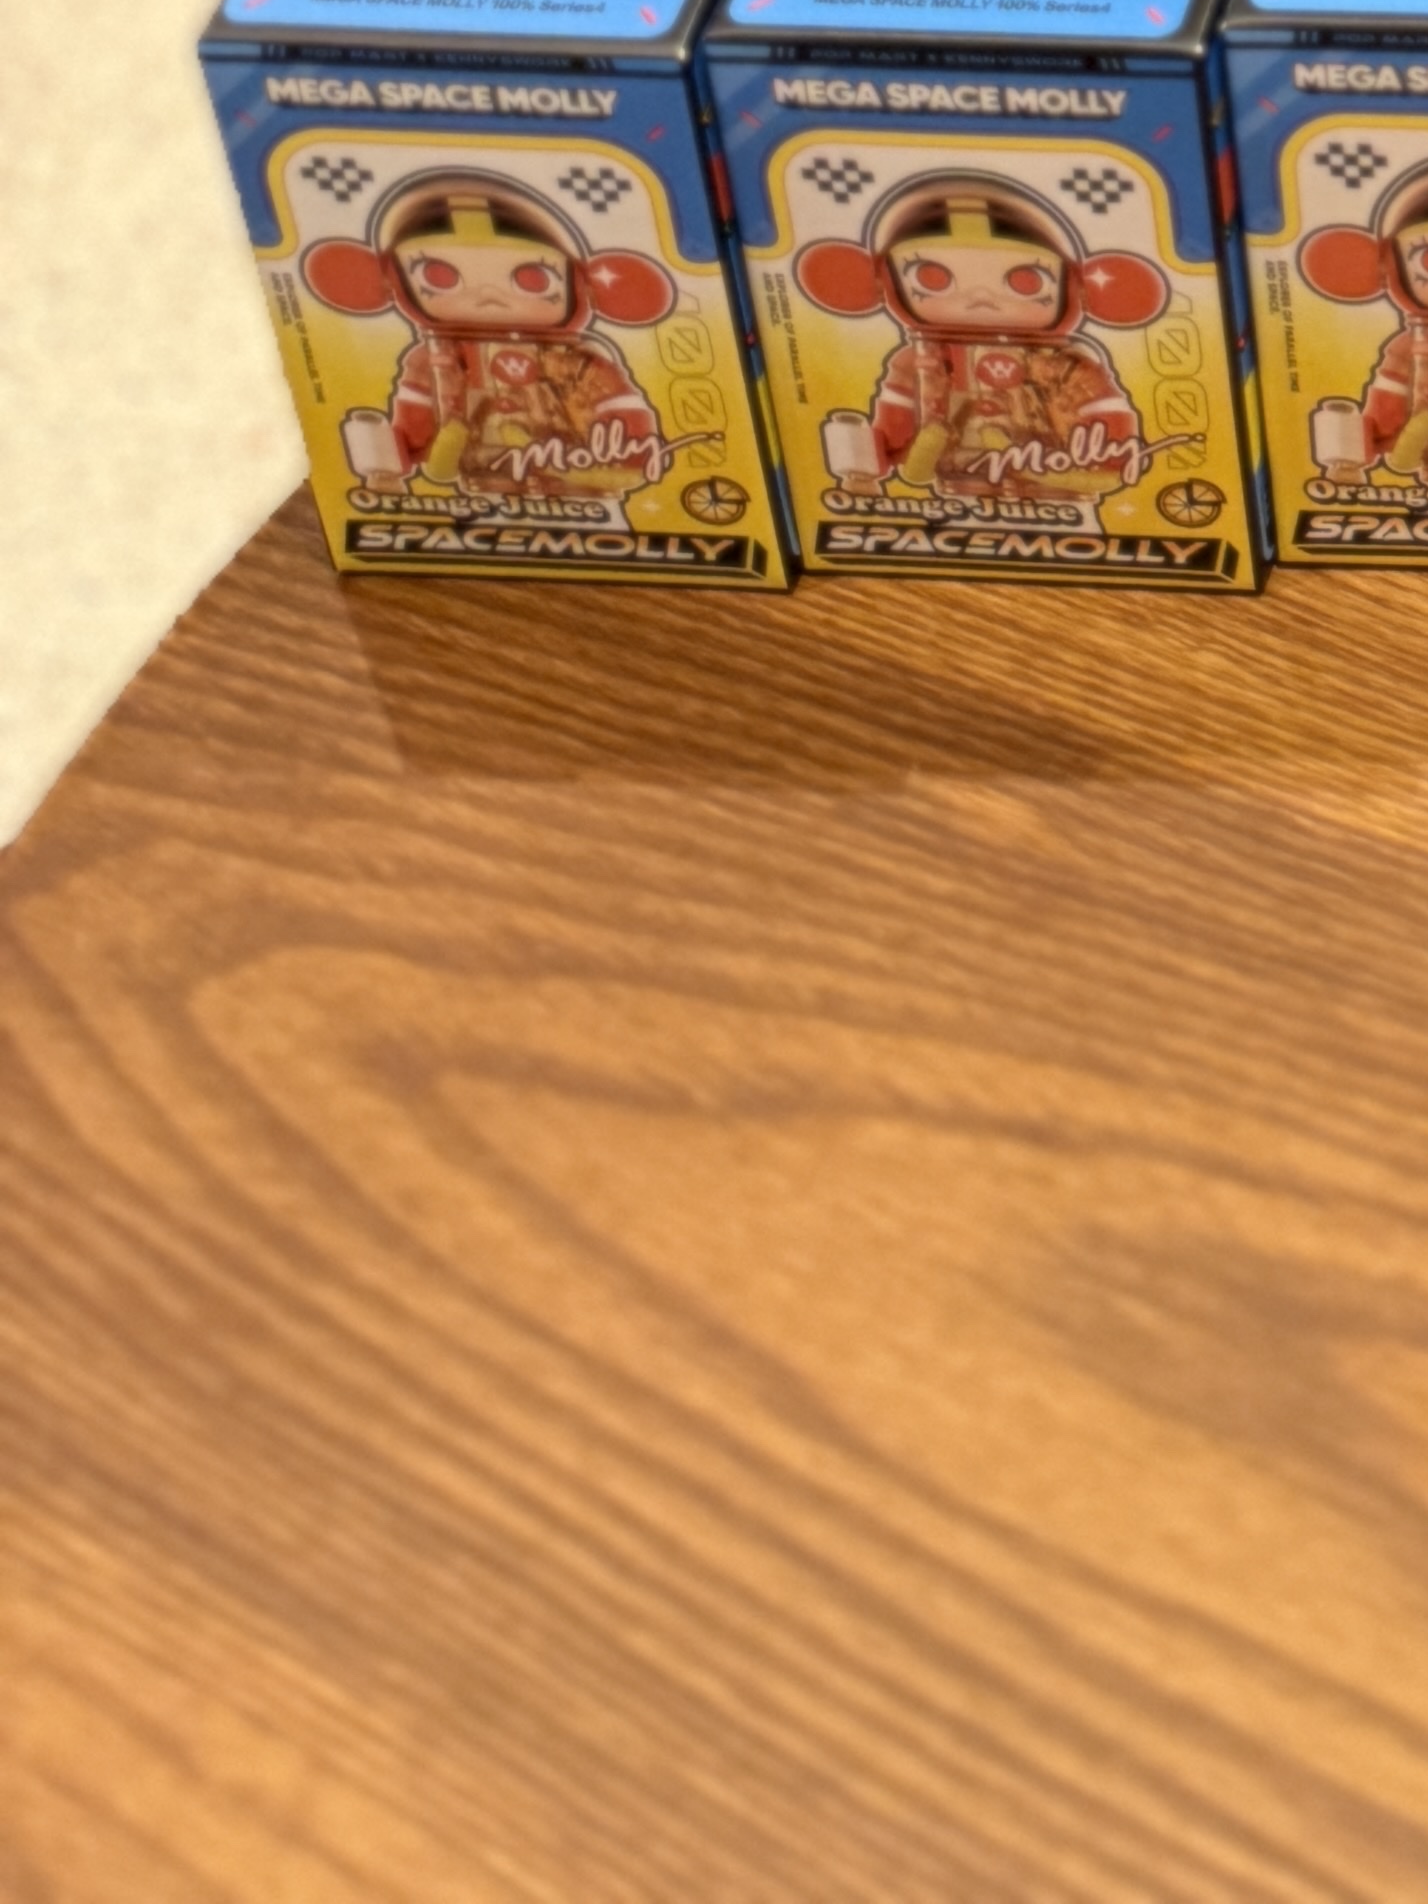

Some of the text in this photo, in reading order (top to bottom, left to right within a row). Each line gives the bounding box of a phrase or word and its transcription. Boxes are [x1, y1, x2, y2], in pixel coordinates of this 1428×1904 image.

[1294, 64, 1401, 90] MEGA
[266, 78, 618, 116] MEGA SPACE MOLLY
[772, 79, 1127, 116] MEGA SPACE MOLLY
[491, 419, 725, 482] Molly
[968, 424, 1206, 483] Molly
[347, 490, 606, 519] Orange Juice
[822, 492, 1080, 522] Orange Juice
